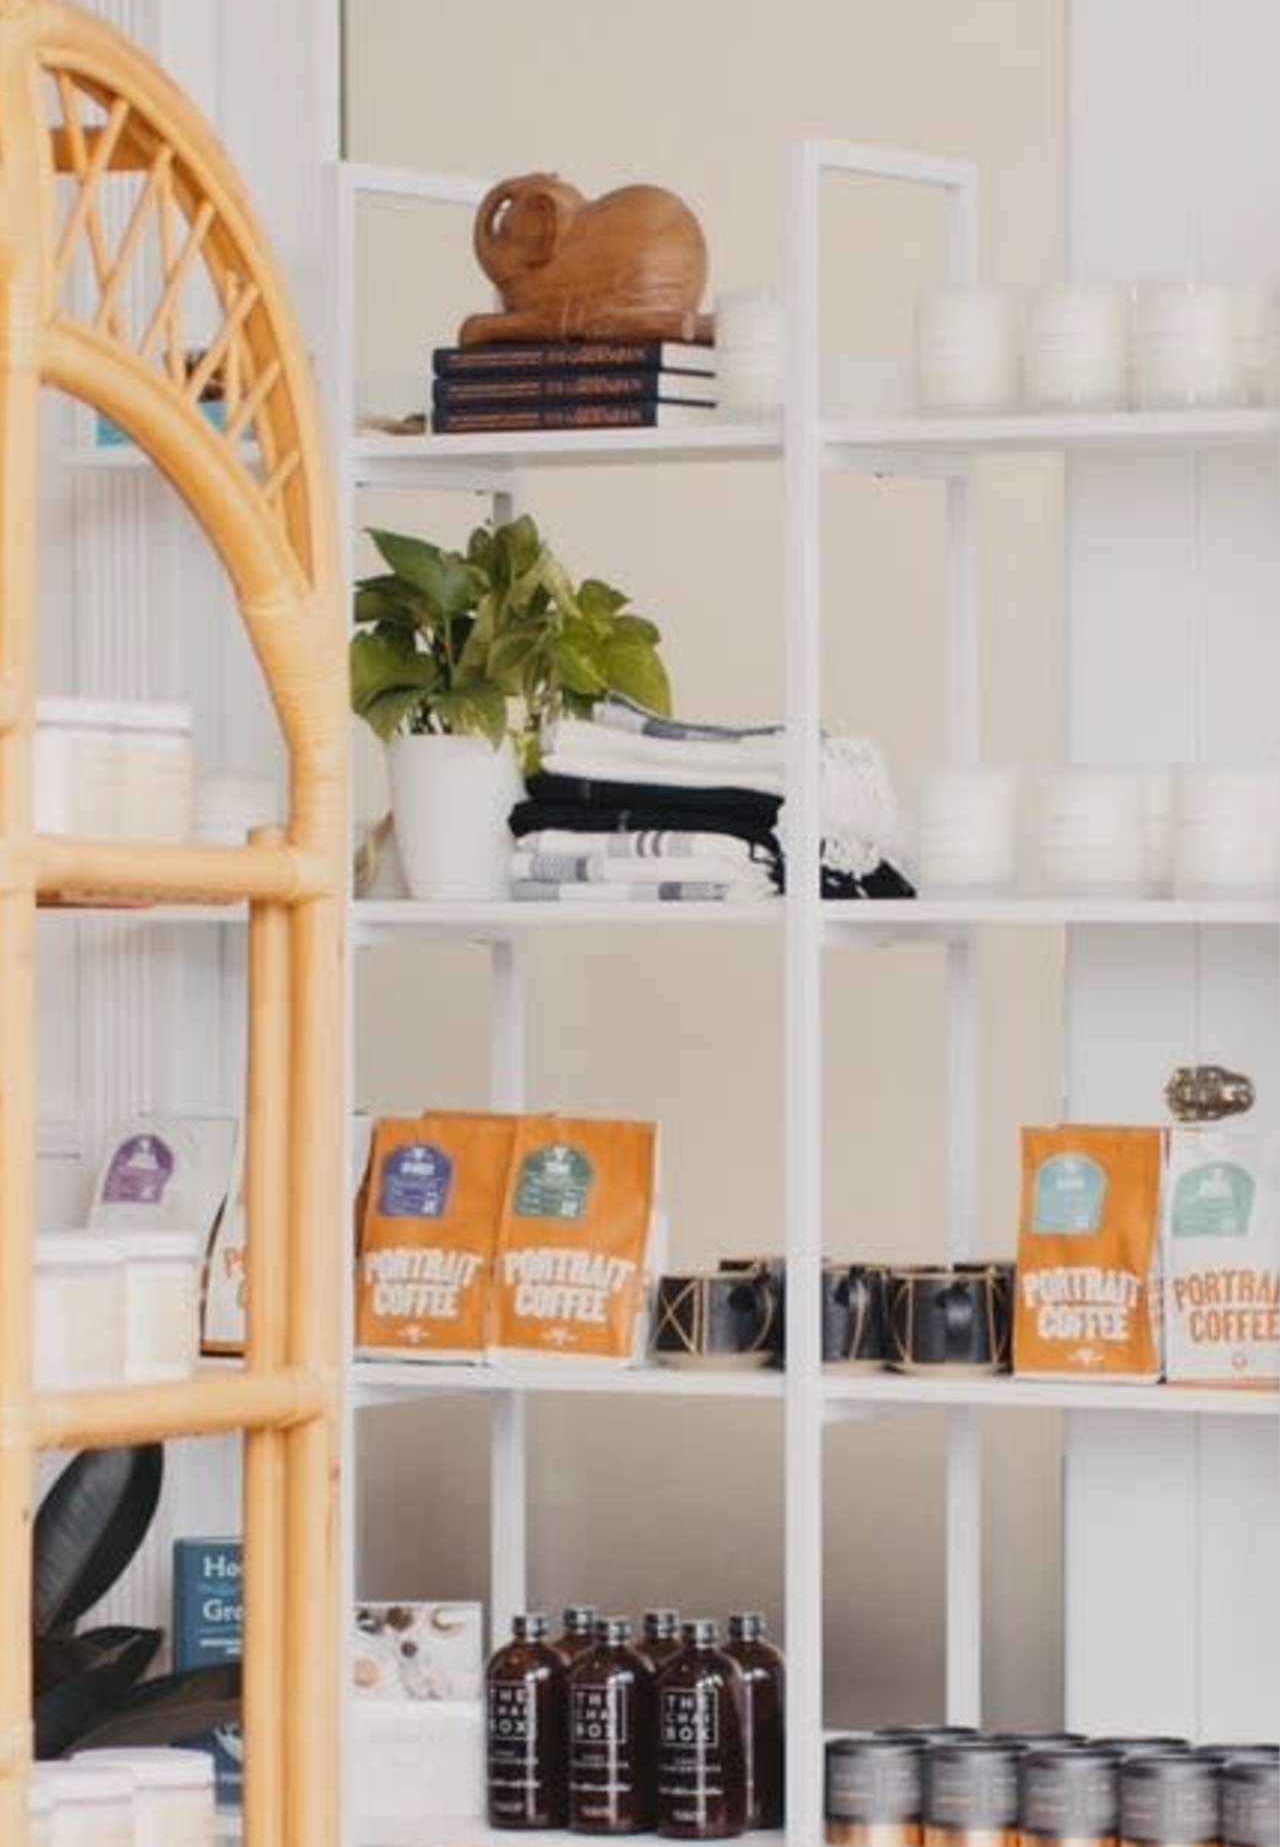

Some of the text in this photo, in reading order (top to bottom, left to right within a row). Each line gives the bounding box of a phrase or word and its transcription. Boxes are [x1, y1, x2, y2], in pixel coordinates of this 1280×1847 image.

[365, 1249, 484, 1287] PORTRAIT
[505, 1249, 637, 1293] PORTRAIT
[374, 1283, 459, 1317] COFFEE
[514, 1284, 608, 1322] COFFEE
[1022, 1267, 1140, 1308] PORTRAIT
[1173, 1269, 1280, 1312] PORTRAI
[1037, 1306, 1130, 1341] COFFEE
[1190, 1310, 1280, 1342] COFFEE
[203, 1556, 242, 1577] Ho
[577, 1692, 613, 1704] TH
